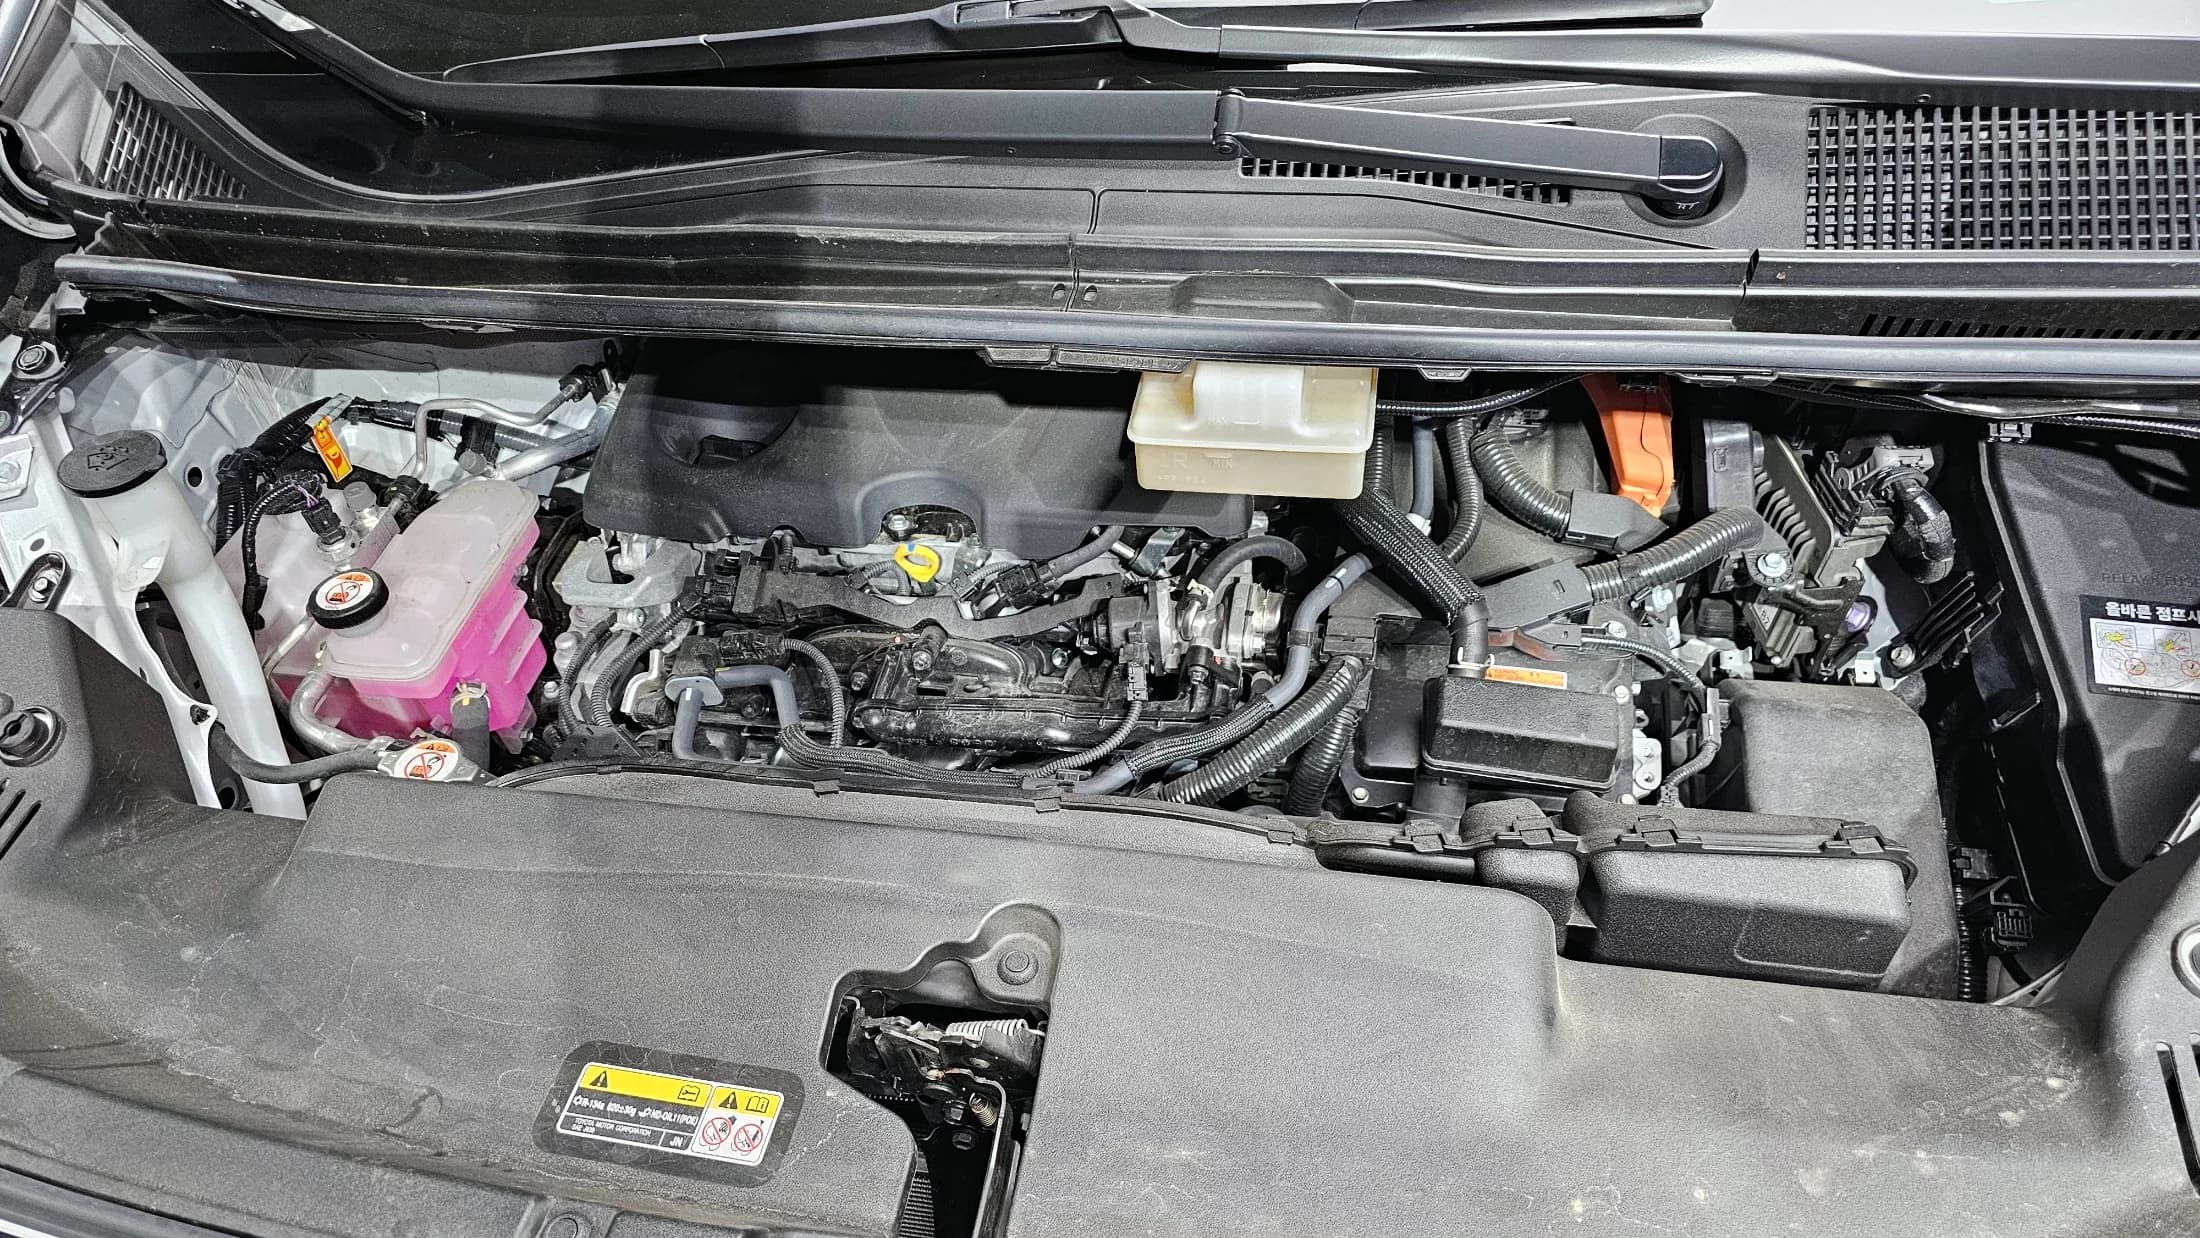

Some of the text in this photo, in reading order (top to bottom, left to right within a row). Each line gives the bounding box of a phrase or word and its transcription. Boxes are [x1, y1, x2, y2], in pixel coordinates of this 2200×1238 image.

[2105, 601, 2152, 619] 올바른
[575, 1117, 652, 1137] TOYOTA MOTOR CORPORATION
